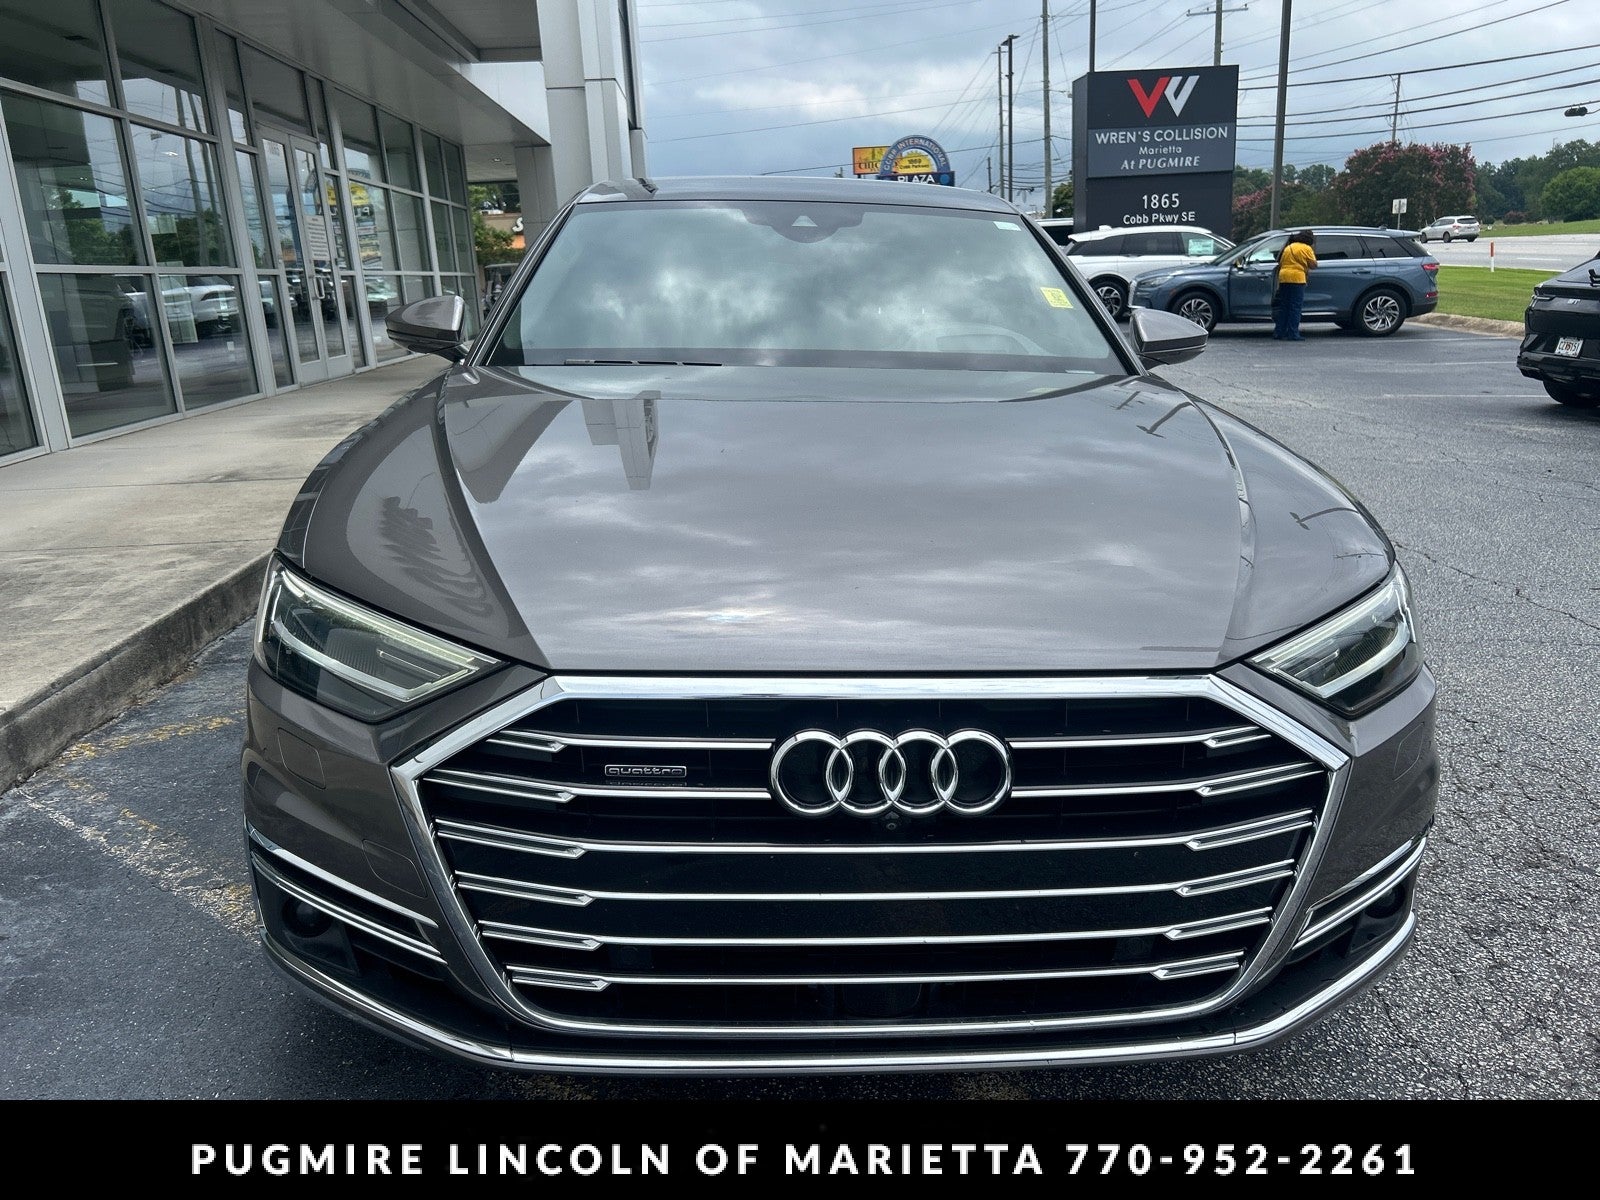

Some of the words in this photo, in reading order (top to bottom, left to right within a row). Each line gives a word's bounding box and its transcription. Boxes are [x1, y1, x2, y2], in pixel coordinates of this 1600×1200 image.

[1095, 130, 1151, 145] WREN'S
[1154, 126, 1228, 142] COLLISION
[897, 138, 947, 167] INTERNATIONAL
[1138, 145, 1182, 155] Marietta
[1121, 159, 1135, 170] At
[1138, 156, 1200, 170] PUGMIRE
[897, 174, 936, 184] PLAZA
[1142, 193, 1180, 209] 1865
[1123, 213, 1149, 225] Cobb
[1152, 212, 1179, 224] Pkwy
[1181, 211, 1196, 222] SE
[608, 767, 683, 776] quattro
